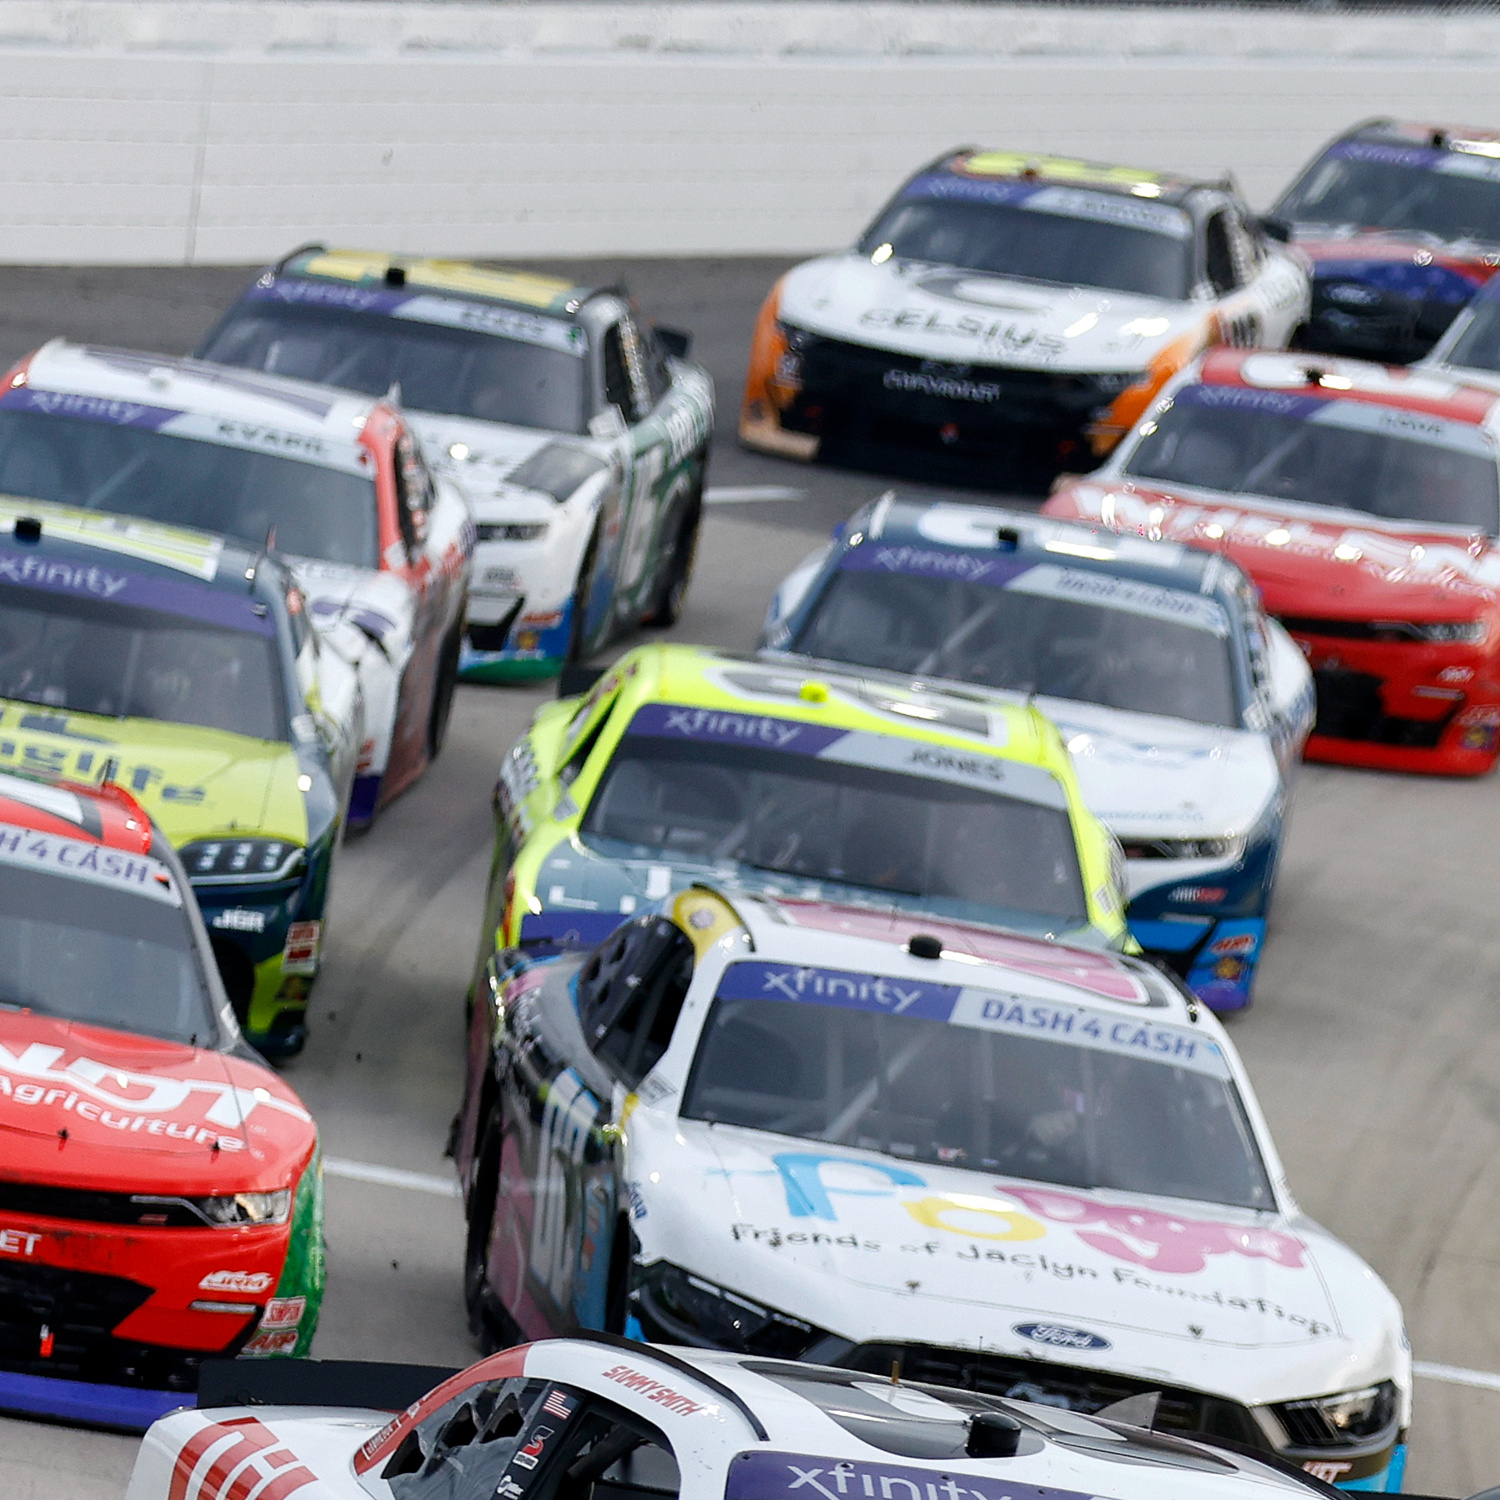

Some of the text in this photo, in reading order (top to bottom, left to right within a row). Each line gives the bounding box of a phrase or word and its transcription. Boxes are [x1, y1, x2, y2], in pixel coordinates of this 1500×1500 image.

[664, 709, 1004, 780] xfinity JONES
[29, 838, 47, 859] 4
[58, 847, 148, 884] CASH
[762, 968, 1197, 1059] xfinity DASH 4 CASH
[731, 1222, 881, 1253] Friends
[956, 1243, 1099, 1281] Jaclyn
[1030, 1322, 1095, 1349] Ford
[602, 1365, 665, 1394] SAMMY
